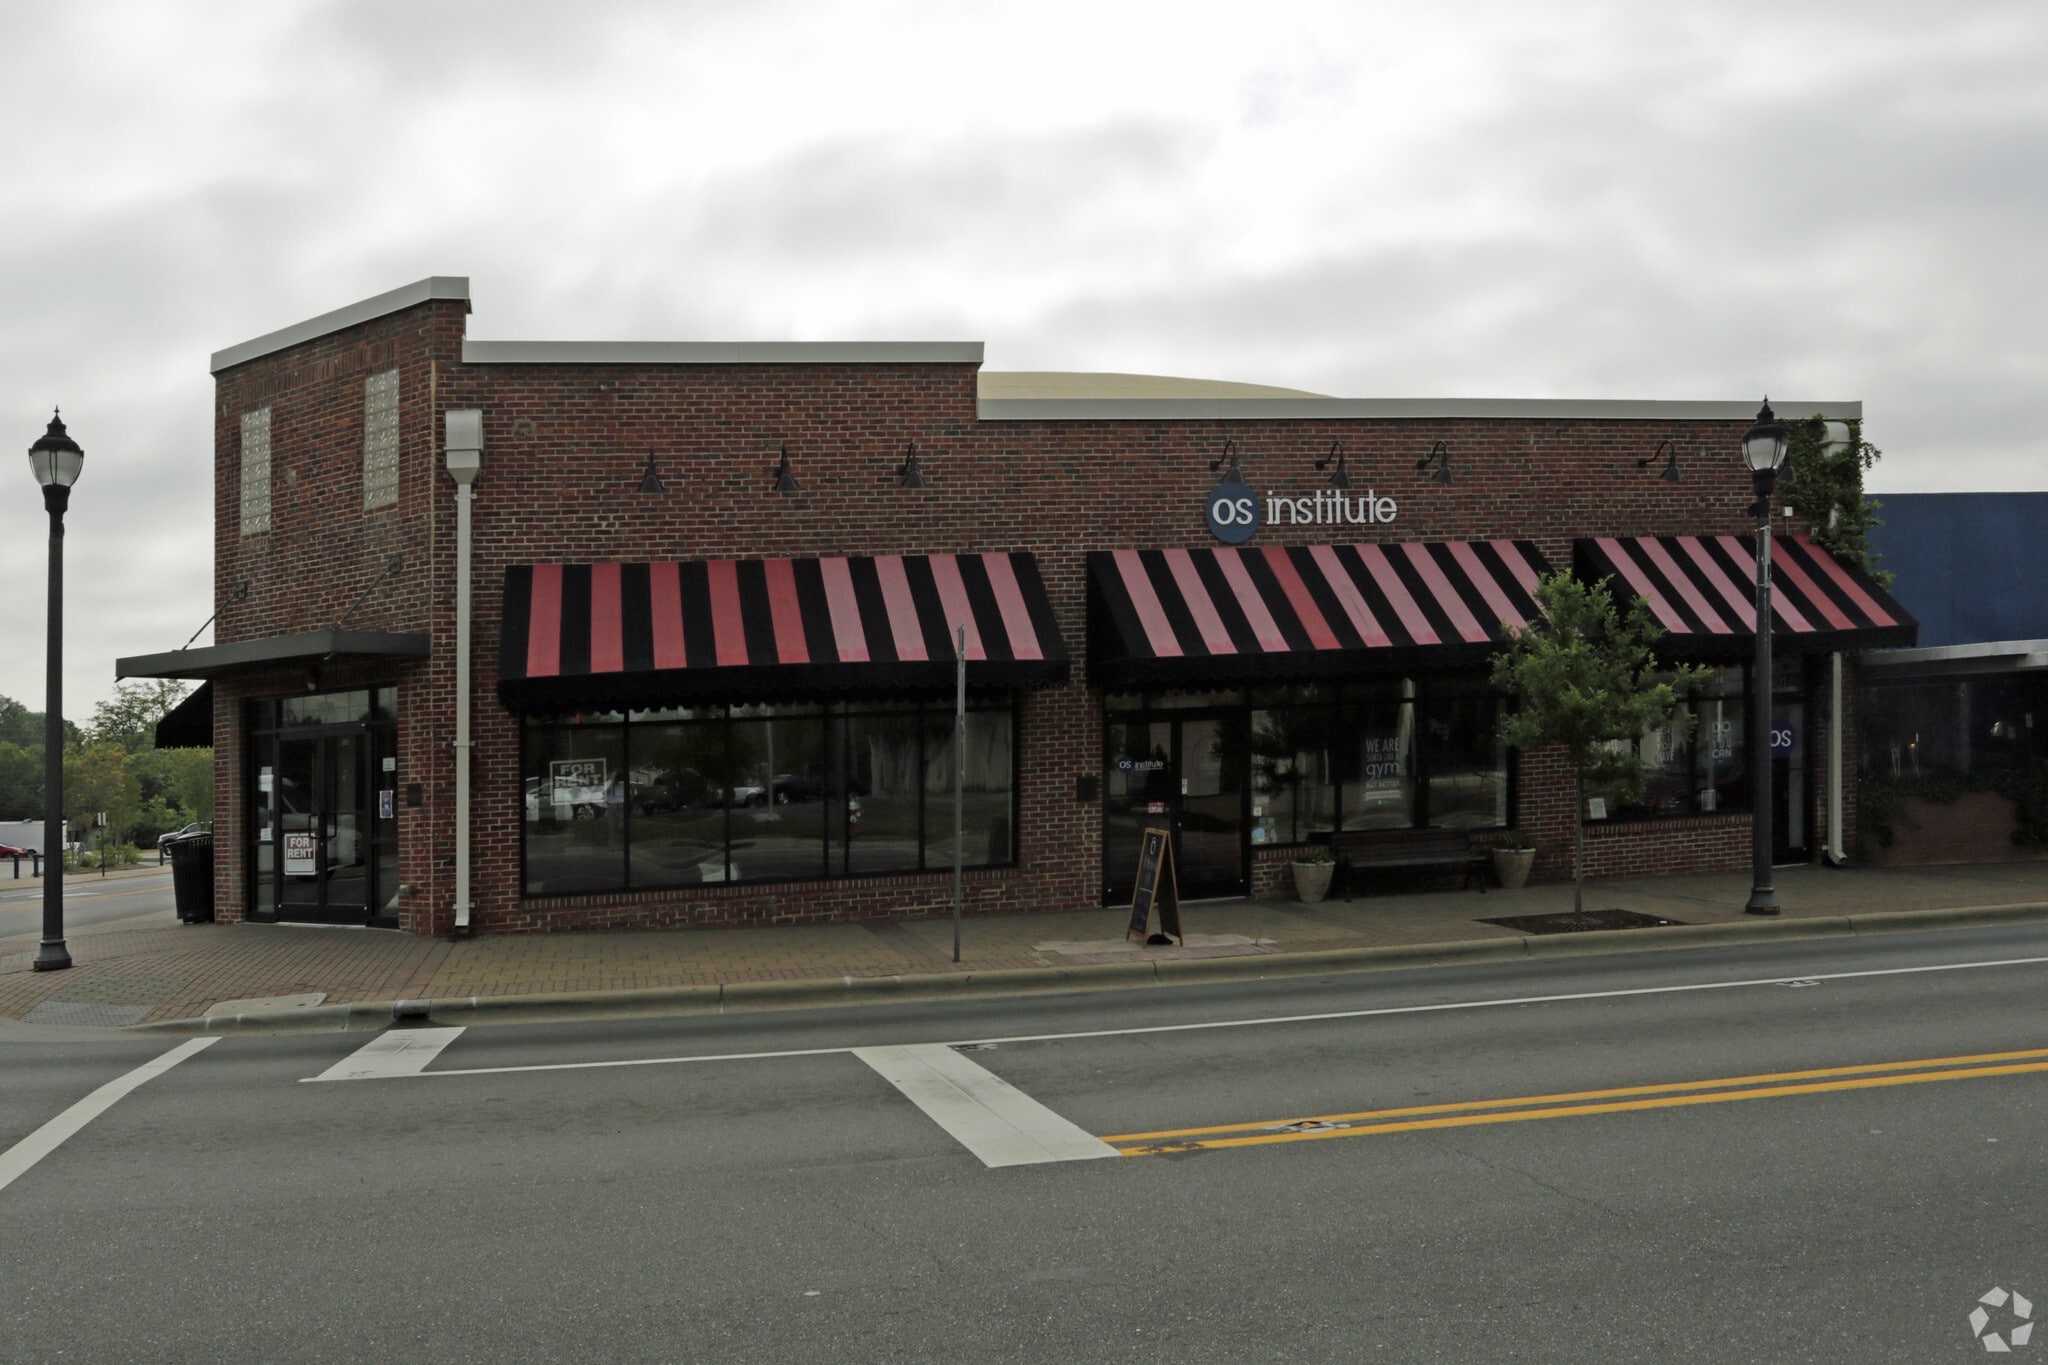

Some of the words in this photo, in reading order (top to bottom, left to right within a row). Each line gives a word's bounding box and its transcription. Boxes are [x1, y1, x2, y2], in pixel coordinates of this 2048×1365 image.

[1266, 489, 1398, 525] institute
[1712, 721, 1732, 733] DO
[1366, 739, 1380, 753] WE
[1382, 737, 1400, 752] ARE
[1712, 737, 1732, 748] YOU
[1712, 749, 1732, 759] CAN
[560, 763, 595, 776] FOR
[1134, 760, 1164, 769] institute
[1366, 762, 1400, 780] gym
[555, 774, 601, 787] RENT
[290, 837, 310, 847] FOR
[287, 848, 313, 858] RENT
